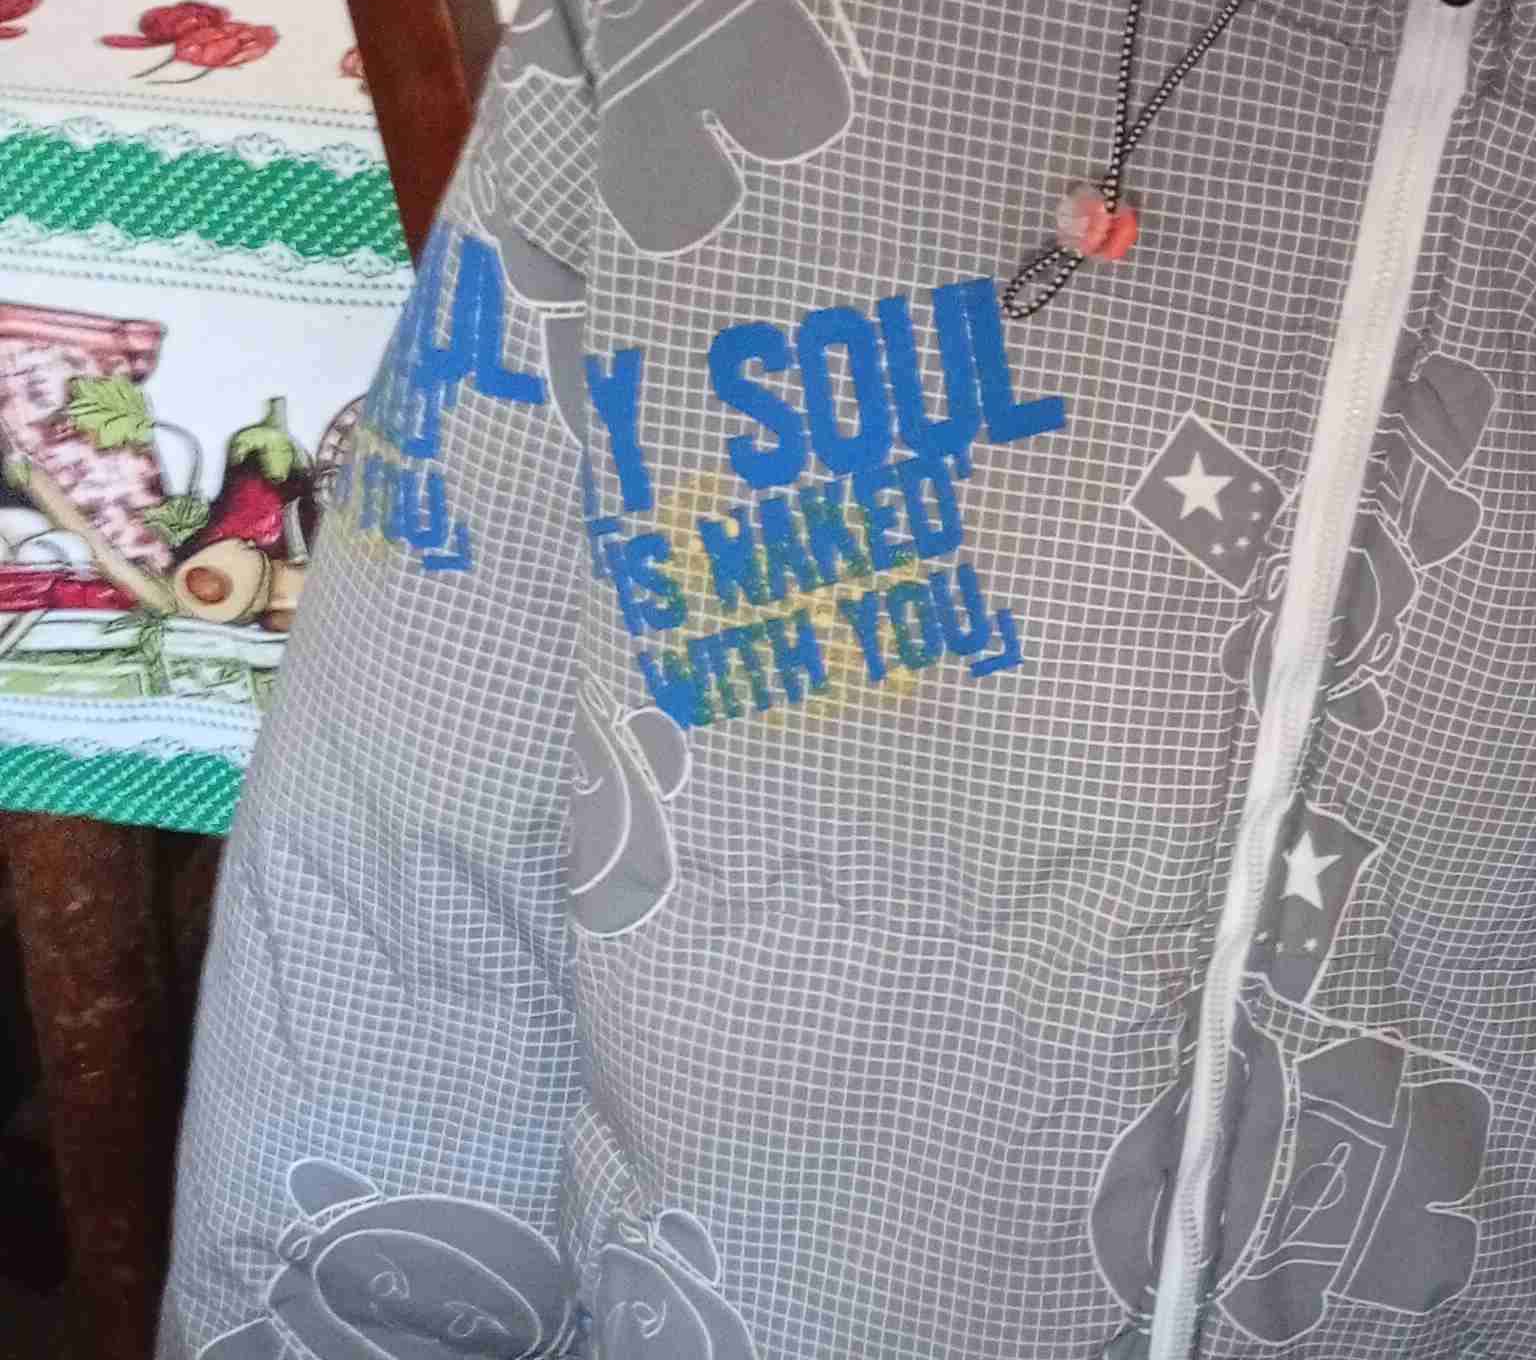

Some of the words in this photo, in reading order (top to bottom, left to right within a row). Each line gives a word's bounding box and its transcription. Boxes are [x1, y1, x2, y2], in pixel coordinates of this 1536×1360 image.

[580, 348, 652, 513] Y
[710, 277, 1066, 488] SOUL
[639, 608, 828, 729] WITH
